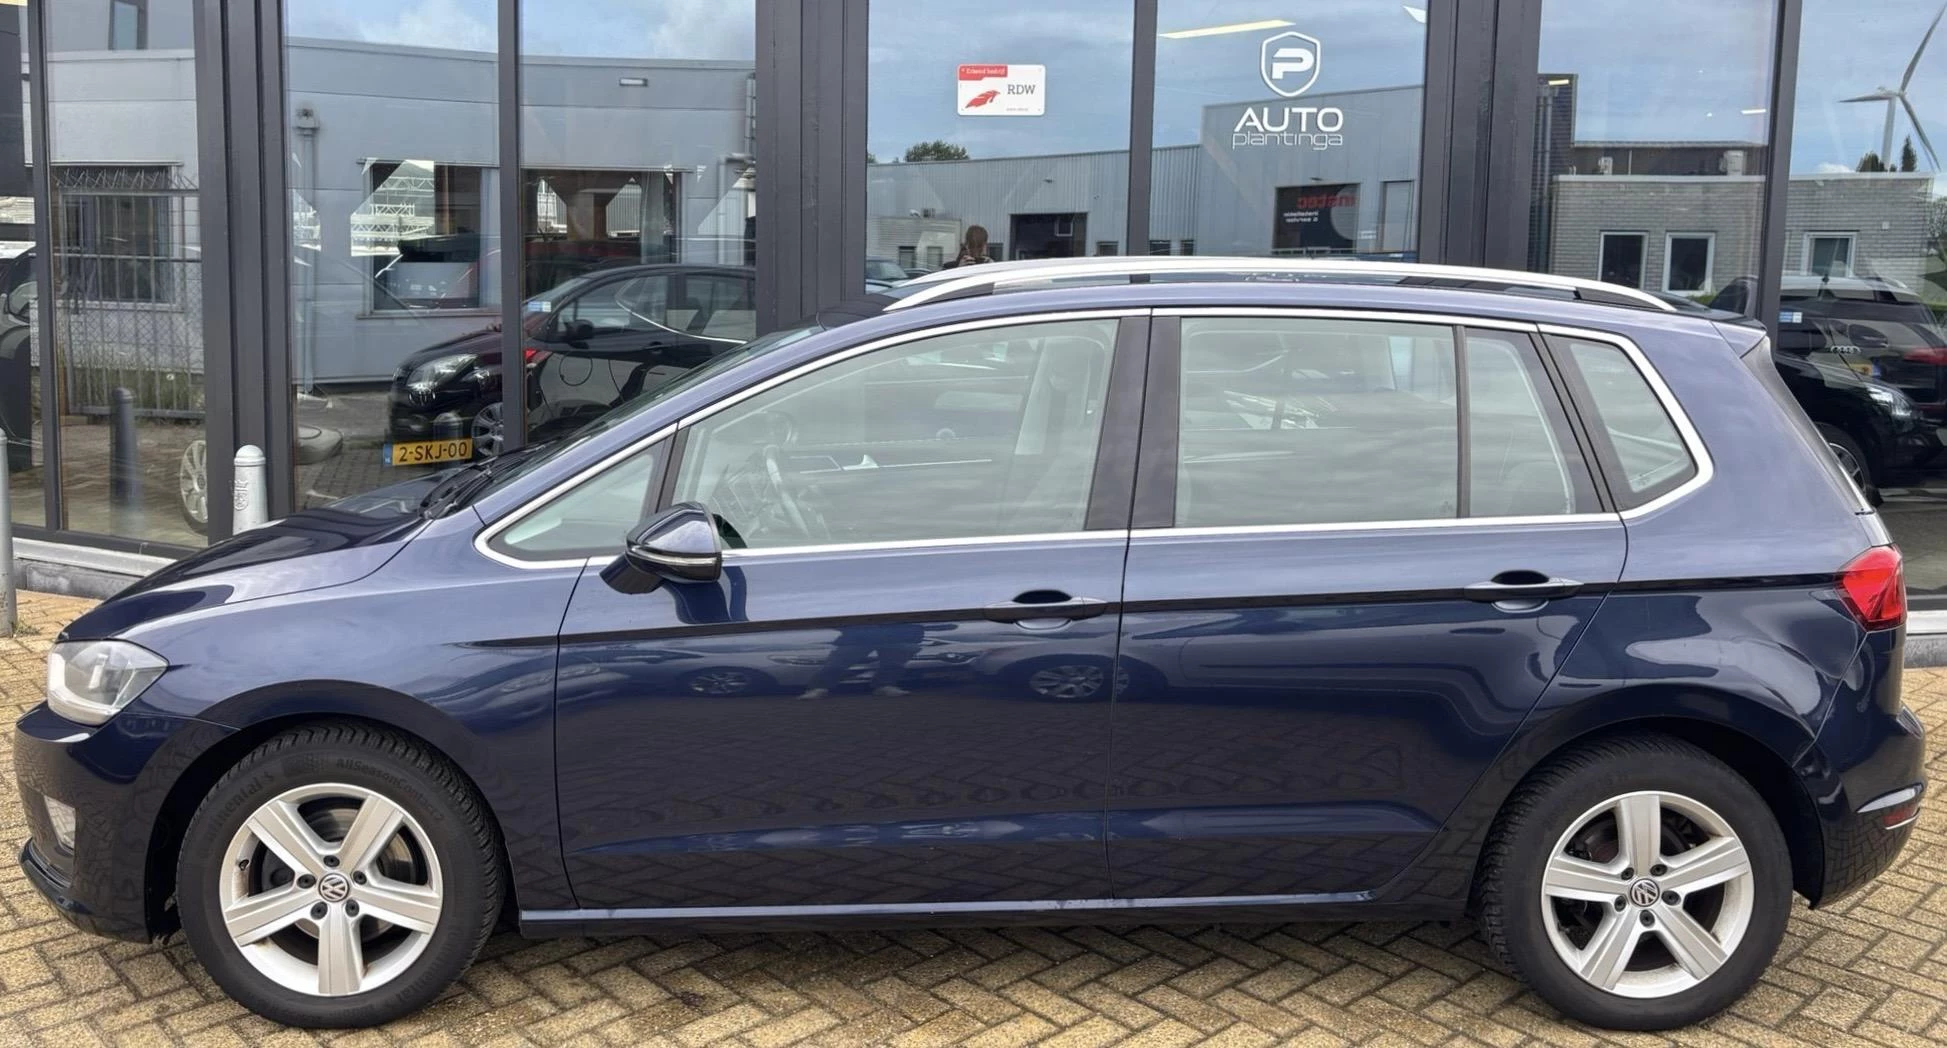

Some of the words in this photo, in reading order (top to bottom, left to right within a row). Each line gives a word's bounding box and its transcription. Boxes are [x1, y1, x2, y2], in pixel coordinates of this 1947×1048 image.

[1007, 84, 1036, 95] RDW
[1234, 107, 1343, 132] AUTO
[1232, 131, 1343, 150] plantinga
[399, 442, 468, 462] 2-SKJ-00
